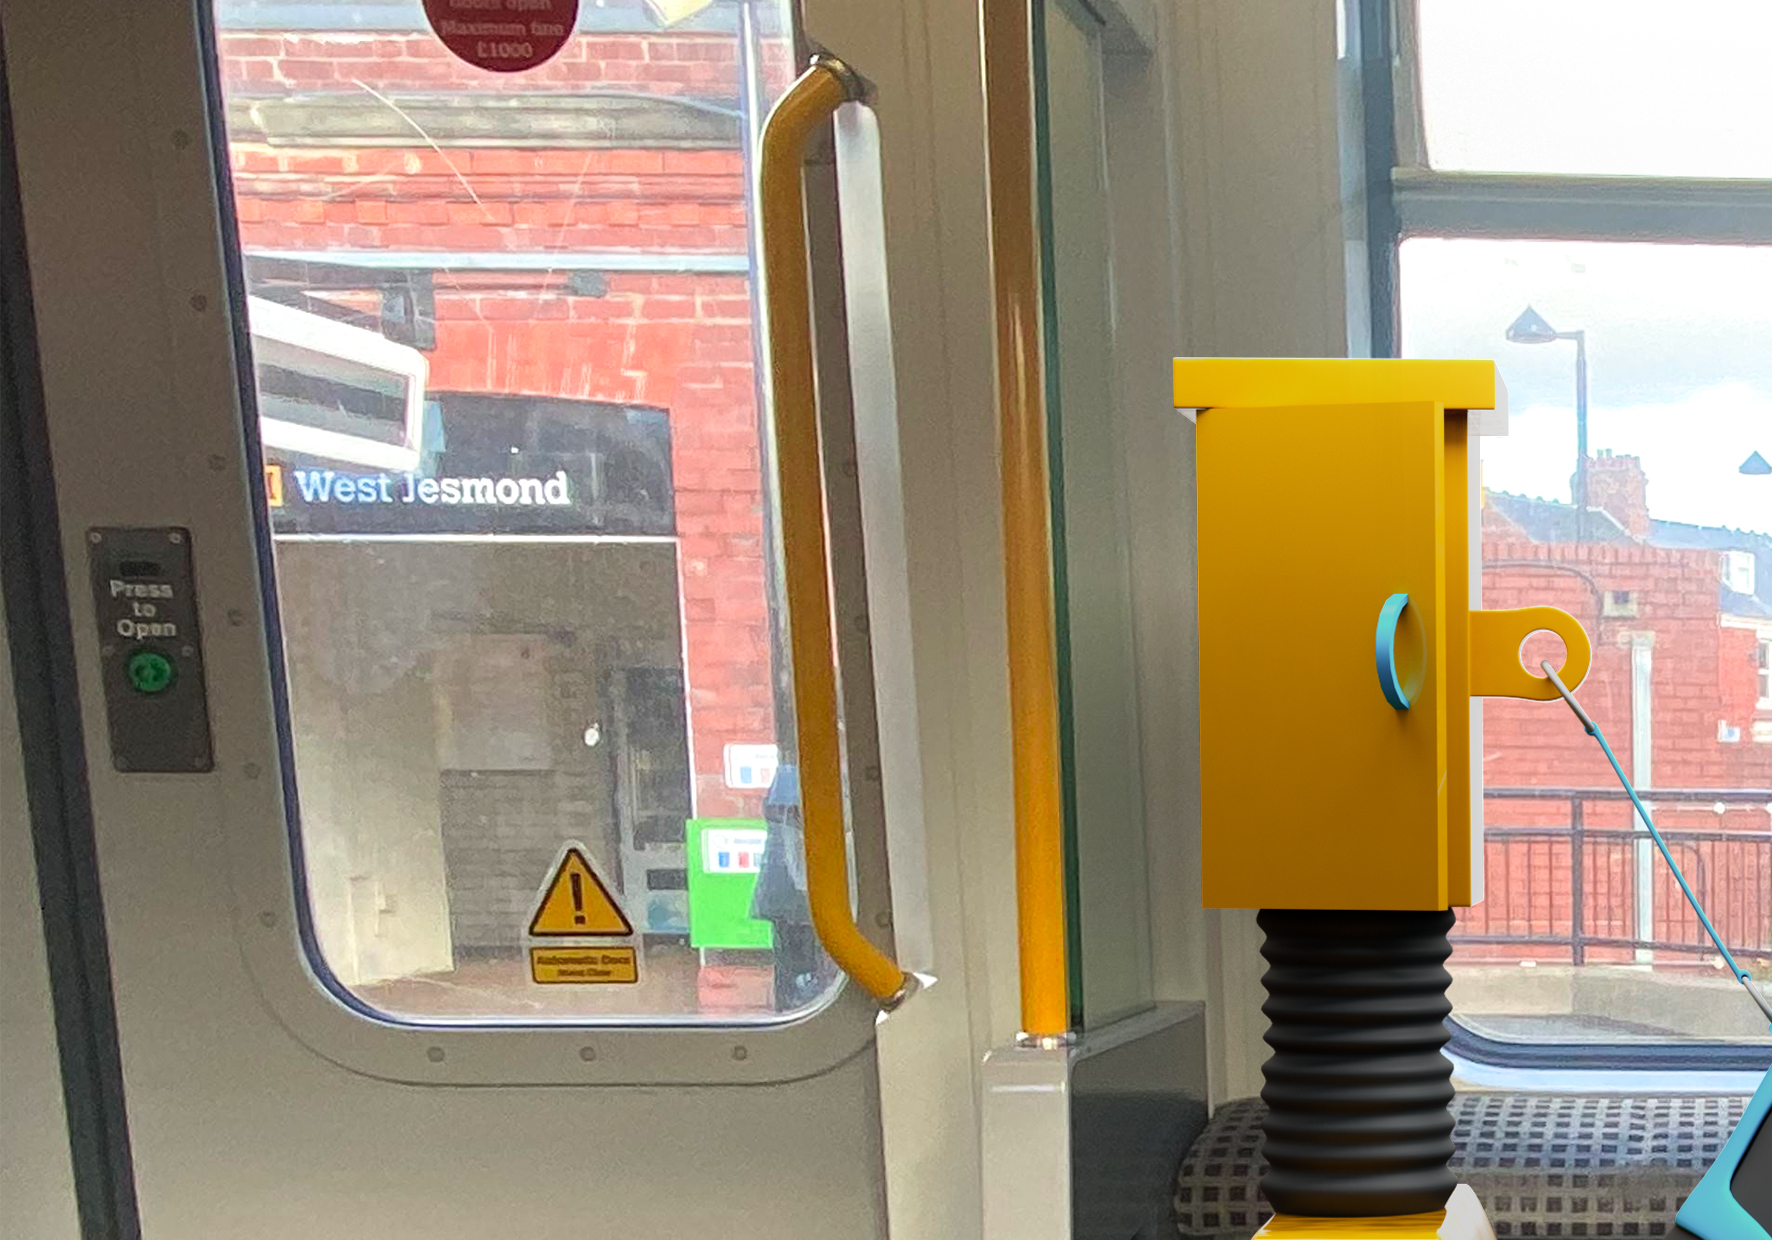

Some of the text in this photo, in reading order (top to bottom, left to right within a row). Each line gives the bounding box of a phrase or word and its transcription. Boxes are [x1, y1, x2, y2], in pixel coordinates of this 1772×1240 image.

[478, 41, 533, 58] £1000
[294, 470, 394, 503] West
[402, 470, 571, 505] Jesmond
[109, 579, 174, 599] Press
[132, 602, 157, 617] to
[116, 618, 177, 640] Open
